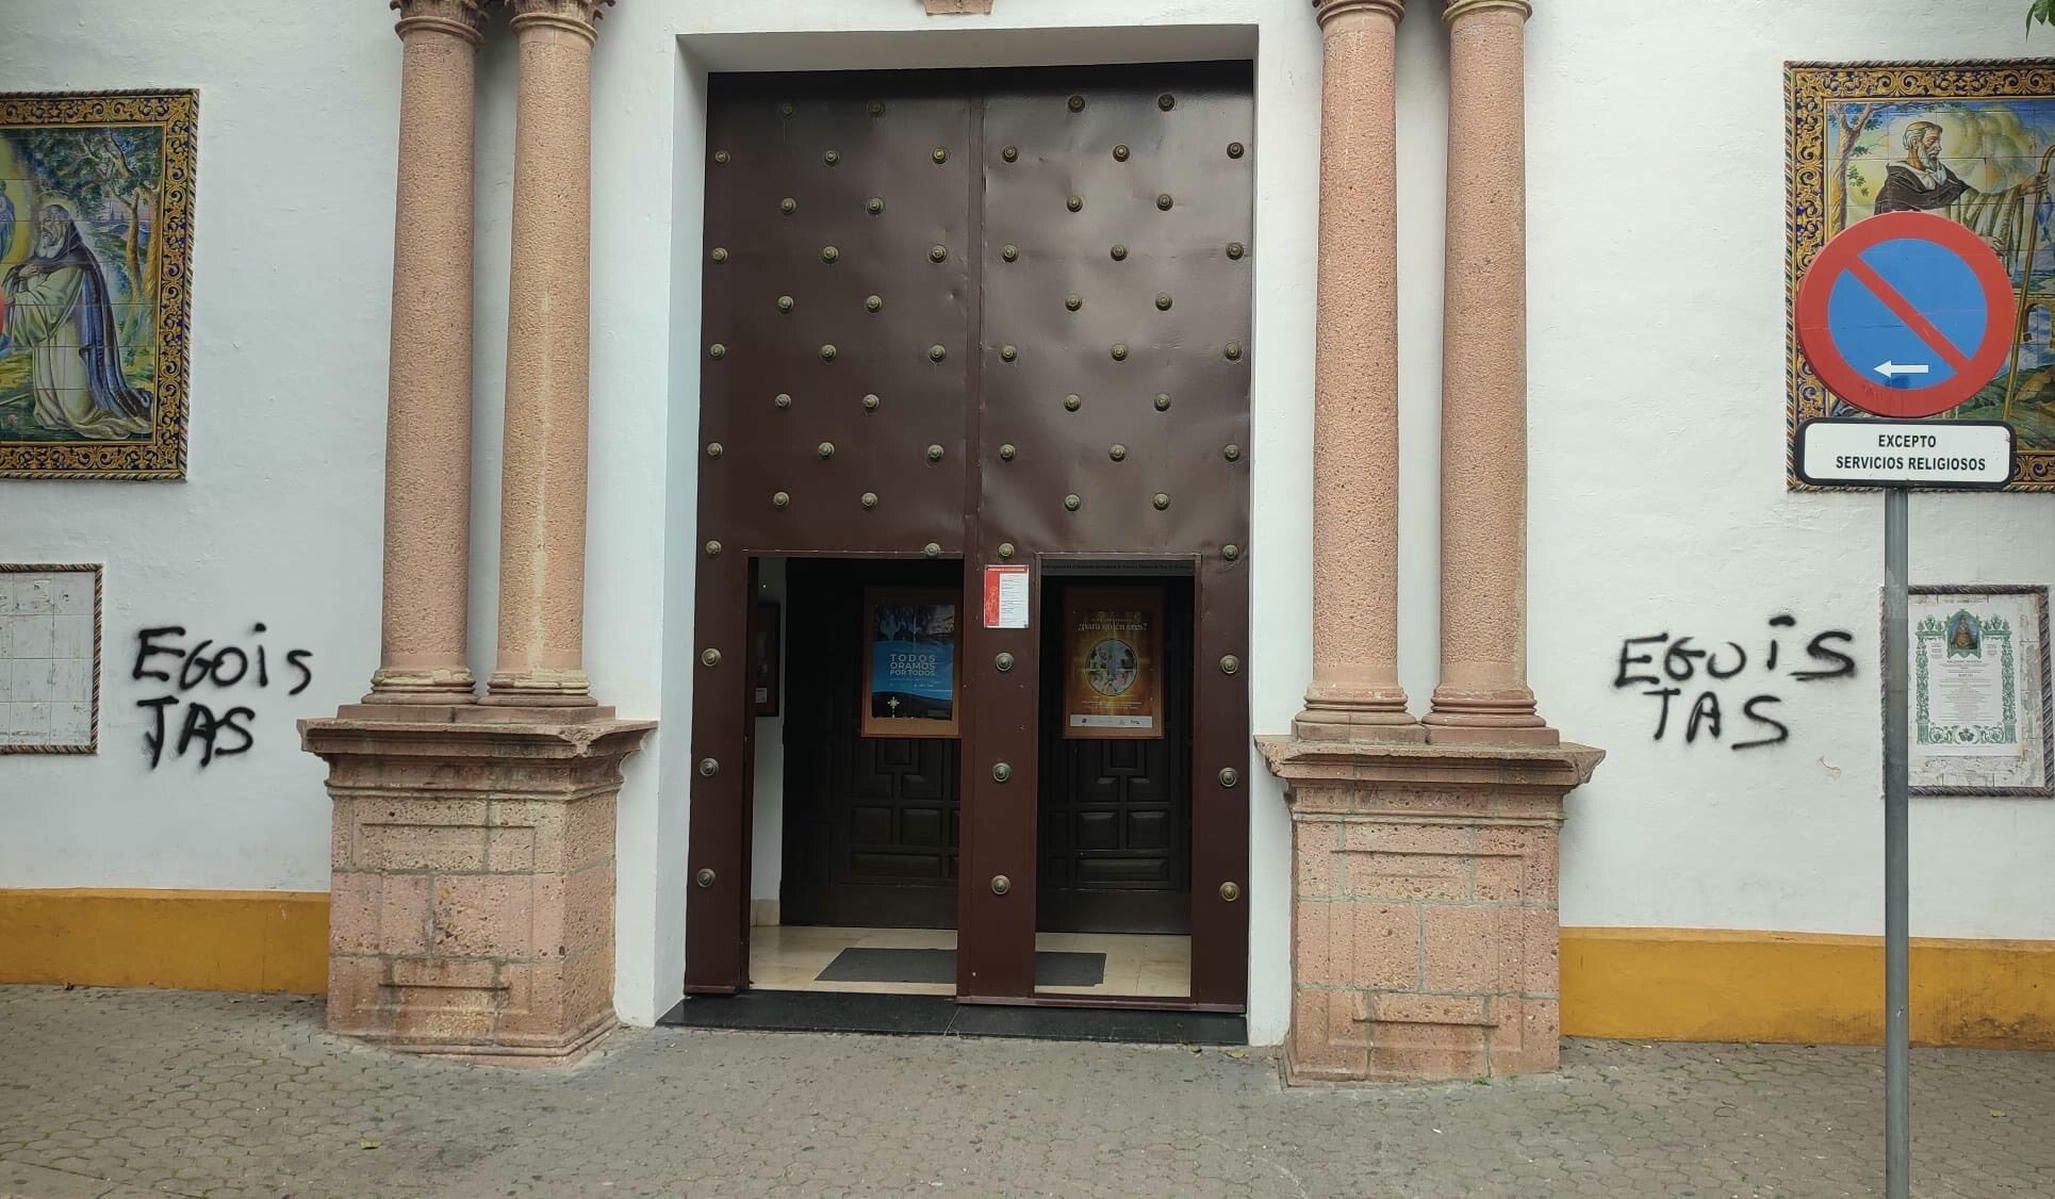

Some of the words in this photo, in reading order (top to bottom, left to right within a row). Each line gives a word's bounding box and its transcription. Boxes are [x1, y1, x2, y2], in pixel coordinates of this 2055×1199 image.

[1878, 434, 1937, 448] EXCEPTO
[1836, 455, 1904, 470] SERVICIOS
[1908, 456, 1986, 471] RELIGIOSOS
[890, 654, 936, 662] TODOS
[890, 662, 936, 670] ORAMOS
[1642, 687, 1789, 751] TAS
[136, 695, 255, 770] TAS
